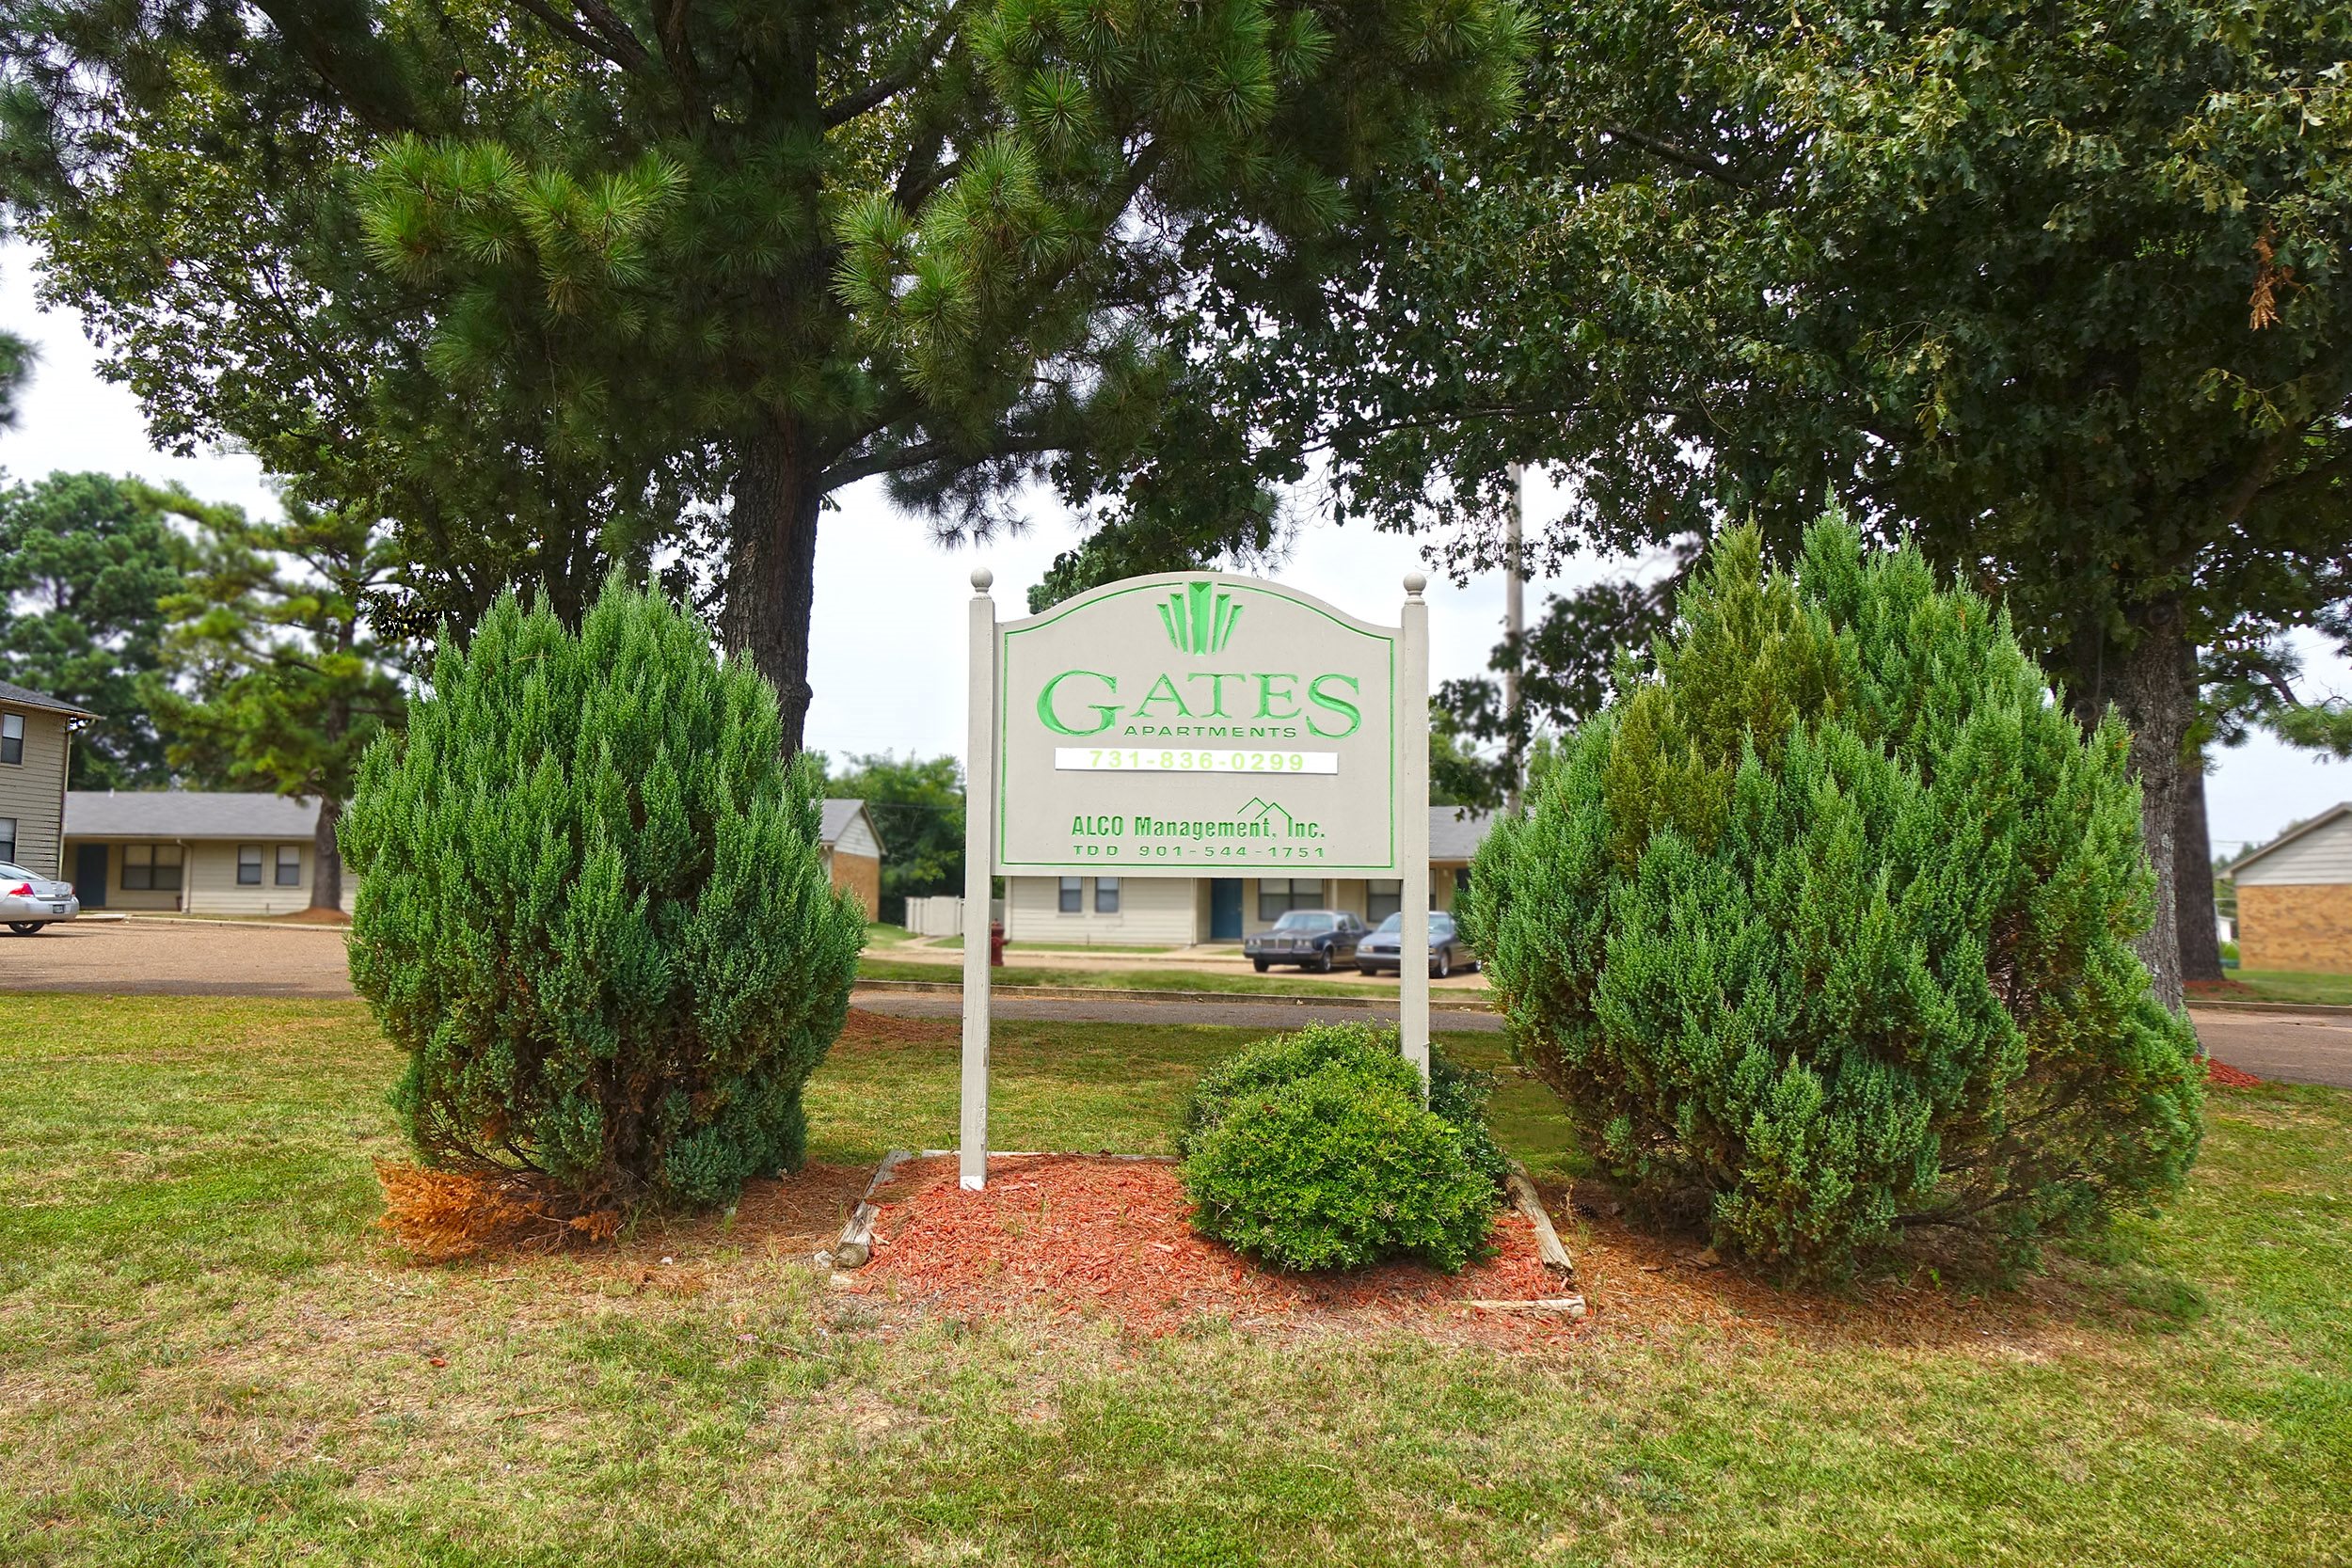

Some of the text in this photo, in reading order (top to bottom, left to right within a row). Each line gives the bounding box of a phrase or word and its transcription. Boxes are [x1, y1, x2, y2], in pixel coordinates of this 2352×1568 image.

[1036, 669, 1362, 739] GATES
[1123, 725, 1297, 738] APARTMENTS
[1089, 750, 1304, 771] 731-836-0299
[1071, 816, 1326, 841] ALCO Management, Inc.
[1073, 845, 1325, 859] TDD 901-544-1751
